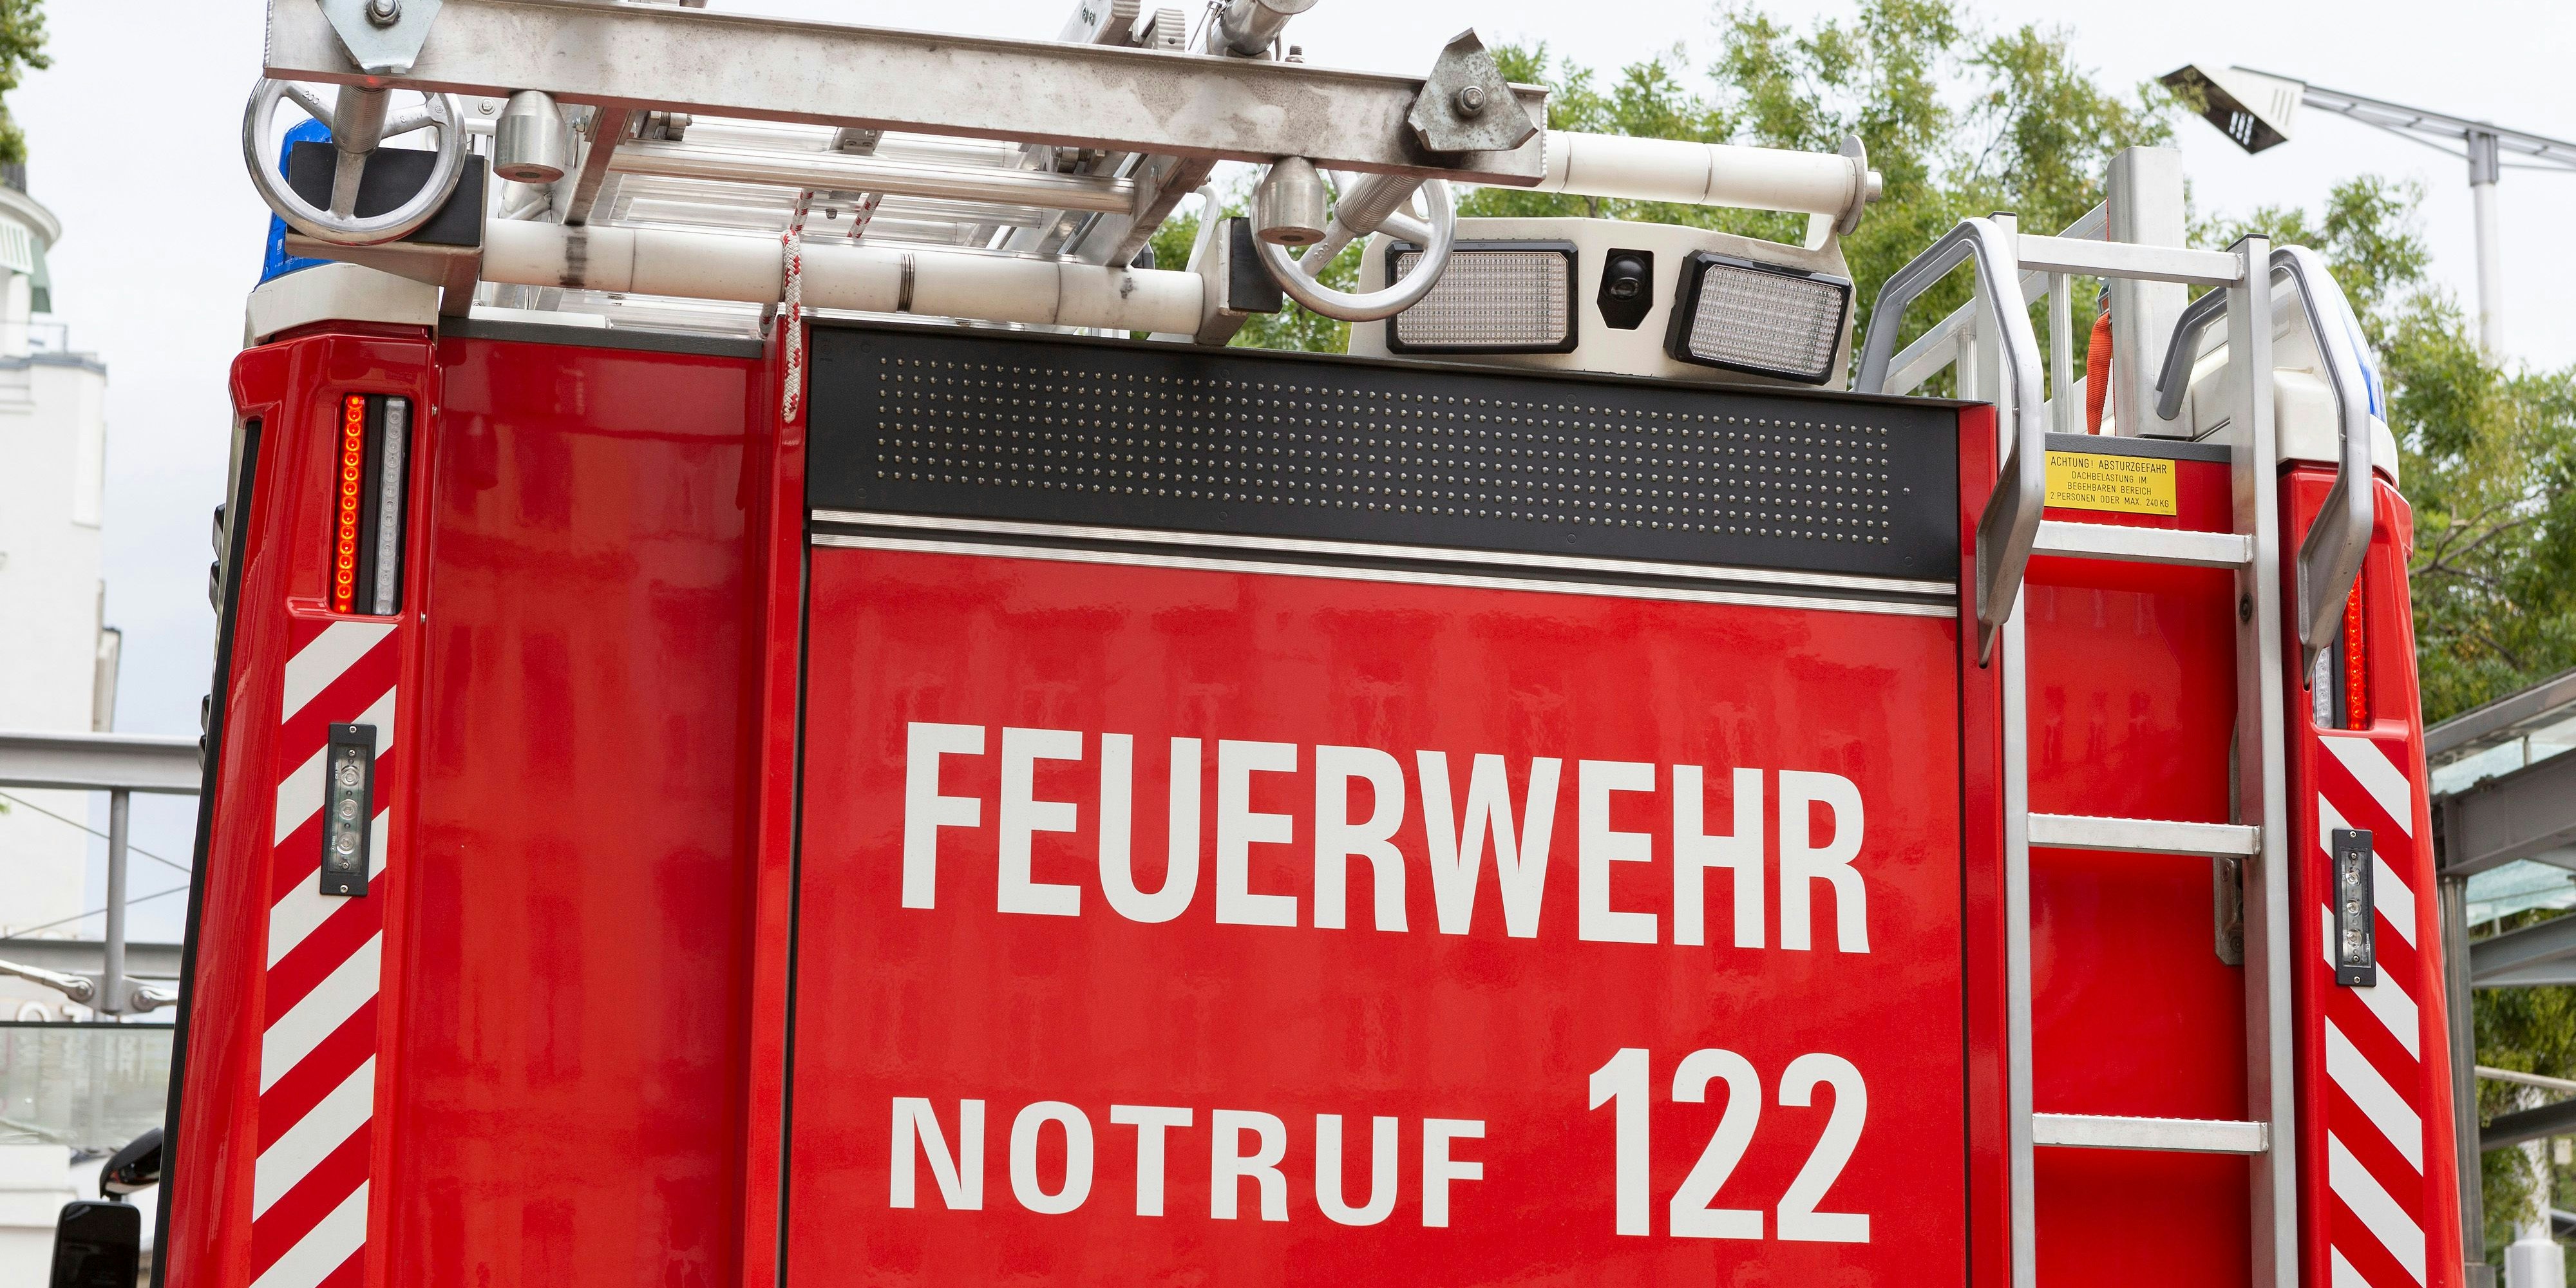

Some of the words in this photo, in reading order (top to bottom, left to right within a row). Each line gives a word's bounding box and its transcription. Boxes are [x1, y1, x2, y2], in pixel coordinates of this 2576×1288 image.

[2050, 456, 2093, 468] ACHTUNG!
[2098, 459, 2167, 474] ABSTURZGEFAHR
[2072, 471, 2134, 483] DACHBELASTUNG
[2067, 482, 2116, 493] BEGEHBAREN
[2121, 486, 2152, 495] BEREICH
[2057, 492, 2096, 502] PERSONEN
[2100, 496, 2119, 504] ODER
[2125, 497, 2141, 506] MAX.
[2146, 498, 2158, 507] 240
[902, 721, 1871, 954] FEUERWEHR
[890, 1097, 1485, 1227] NOTRUF
[1589, 1047, 1870, 1244] 122
